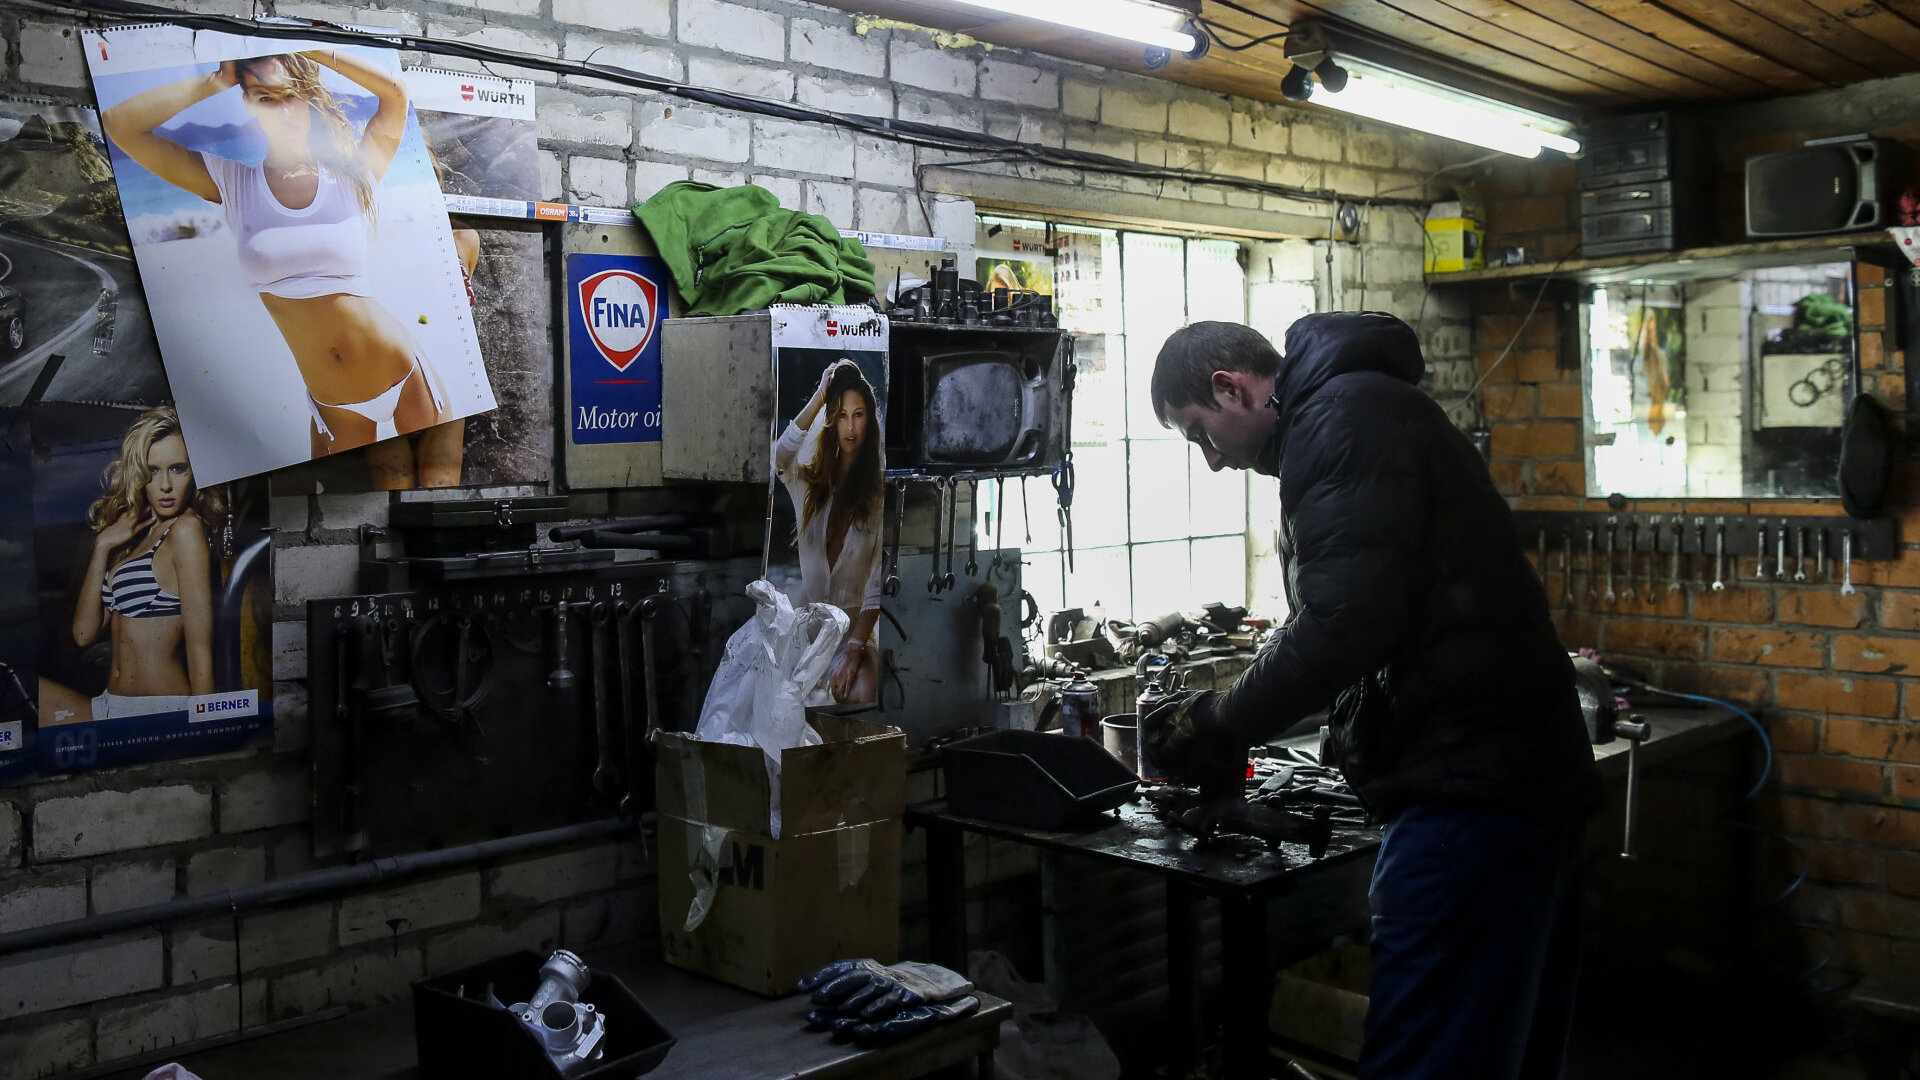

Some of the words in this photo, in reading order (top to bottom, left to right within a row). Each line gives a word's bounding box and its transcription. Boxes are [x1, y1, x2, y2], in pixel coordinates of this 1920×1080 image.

[477, 89, 525, 106] WÜRTH
[540, 207, 566, 217] OSRAM
[593, 297, 646, 328] FINA
[840, 324, 881, 337] WÜRTH
[577, 405, 638, 430] Motor
[643, 404, 662, 428] oi
[610, 582, 622, 597] 19
[658, 578, 670, 593] 21
[207, 698, 250, 713] BERNER
